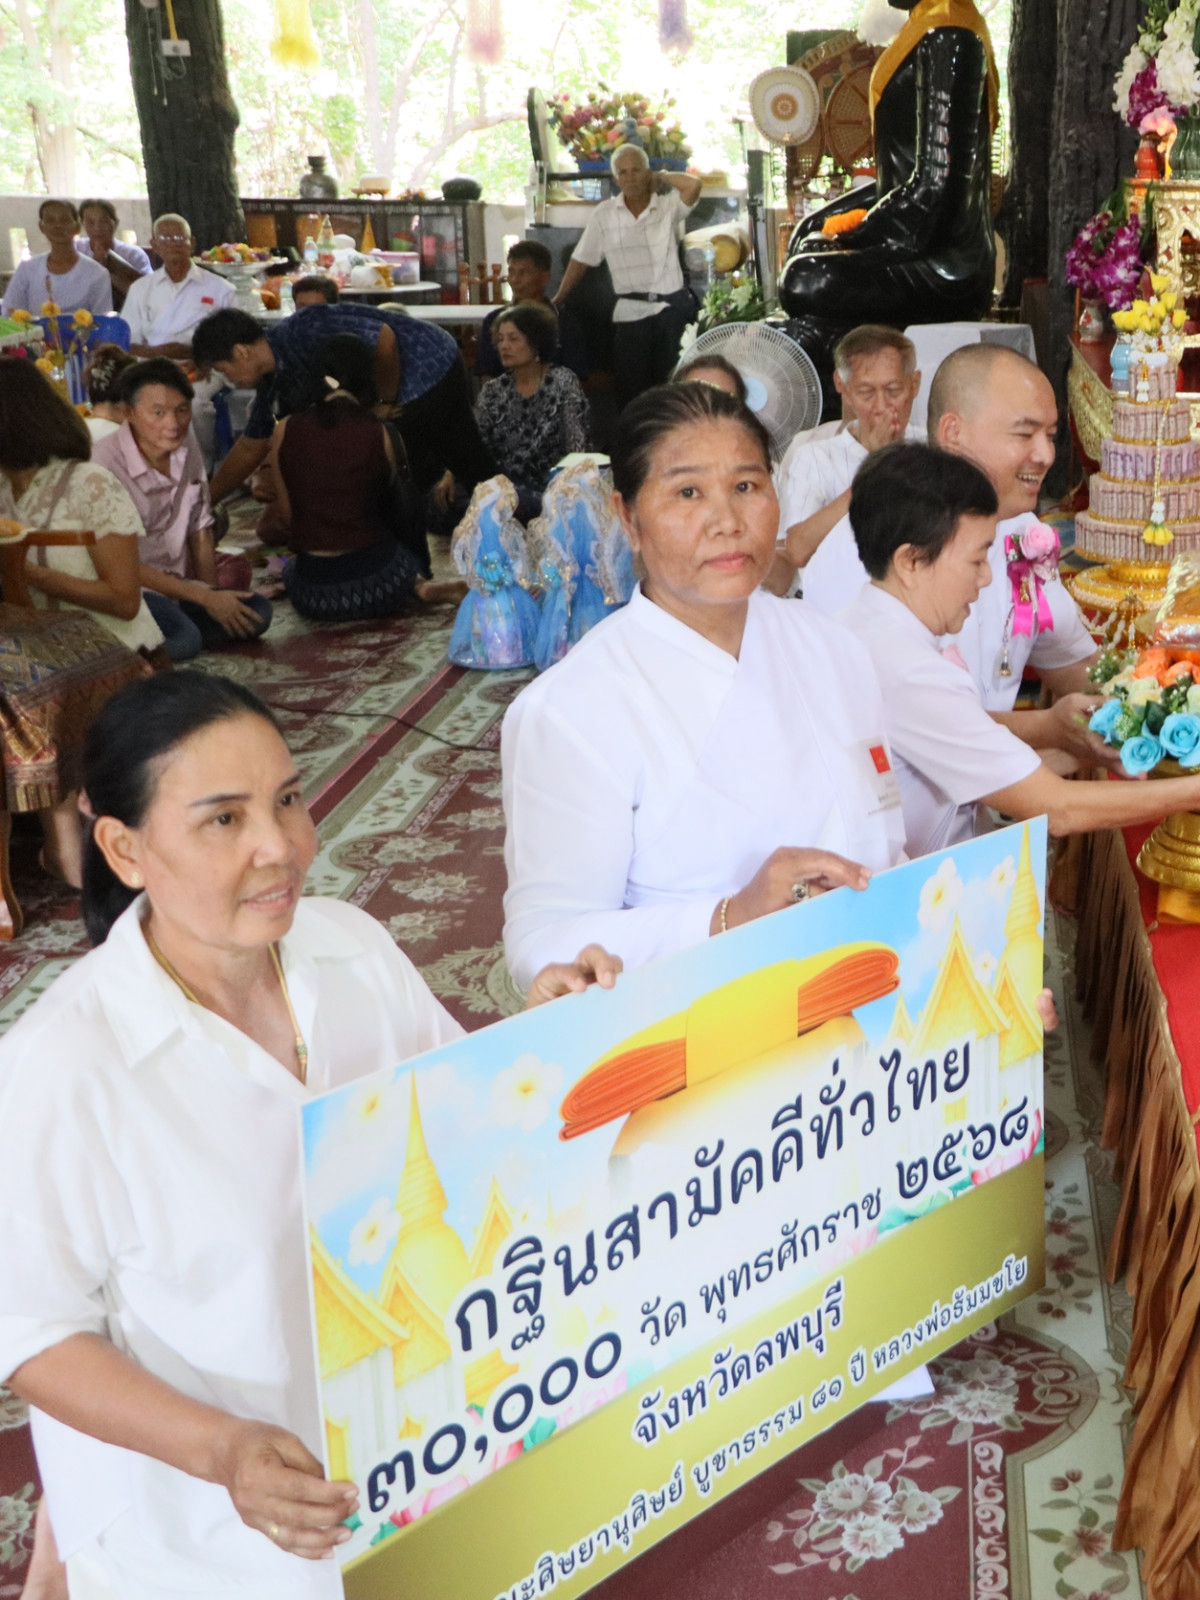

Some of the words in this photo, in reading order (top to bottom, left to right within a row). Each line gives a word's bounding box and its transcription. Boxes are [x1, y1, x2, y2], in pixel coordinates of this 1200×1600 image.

[366, 1331, 622, 1514] ๓๐,๐๐๐
[640, 1295, 688, 1346] วัด
[700, 1188, 882, 1324] พุทธศักราช
[895, 1096, 1029, 1200] ๒๕๖๘
[455, 1041, 971, 1351] กฐินสามัคคีทั่วไทย
[496, 1465, 683, 1600] ะศิษยานุศิษย์
[693, 1401, 804, 1493] บูชาธรรม
[812, 1378, 842, 1409] ๘๑
[851, 1350, 866, 1383] ปี
[875, 1258, 1027, 1369] หลวงพ่อธัมมชโย
[634, 1279, 844, 1444] จังหวัดลพบุรี
